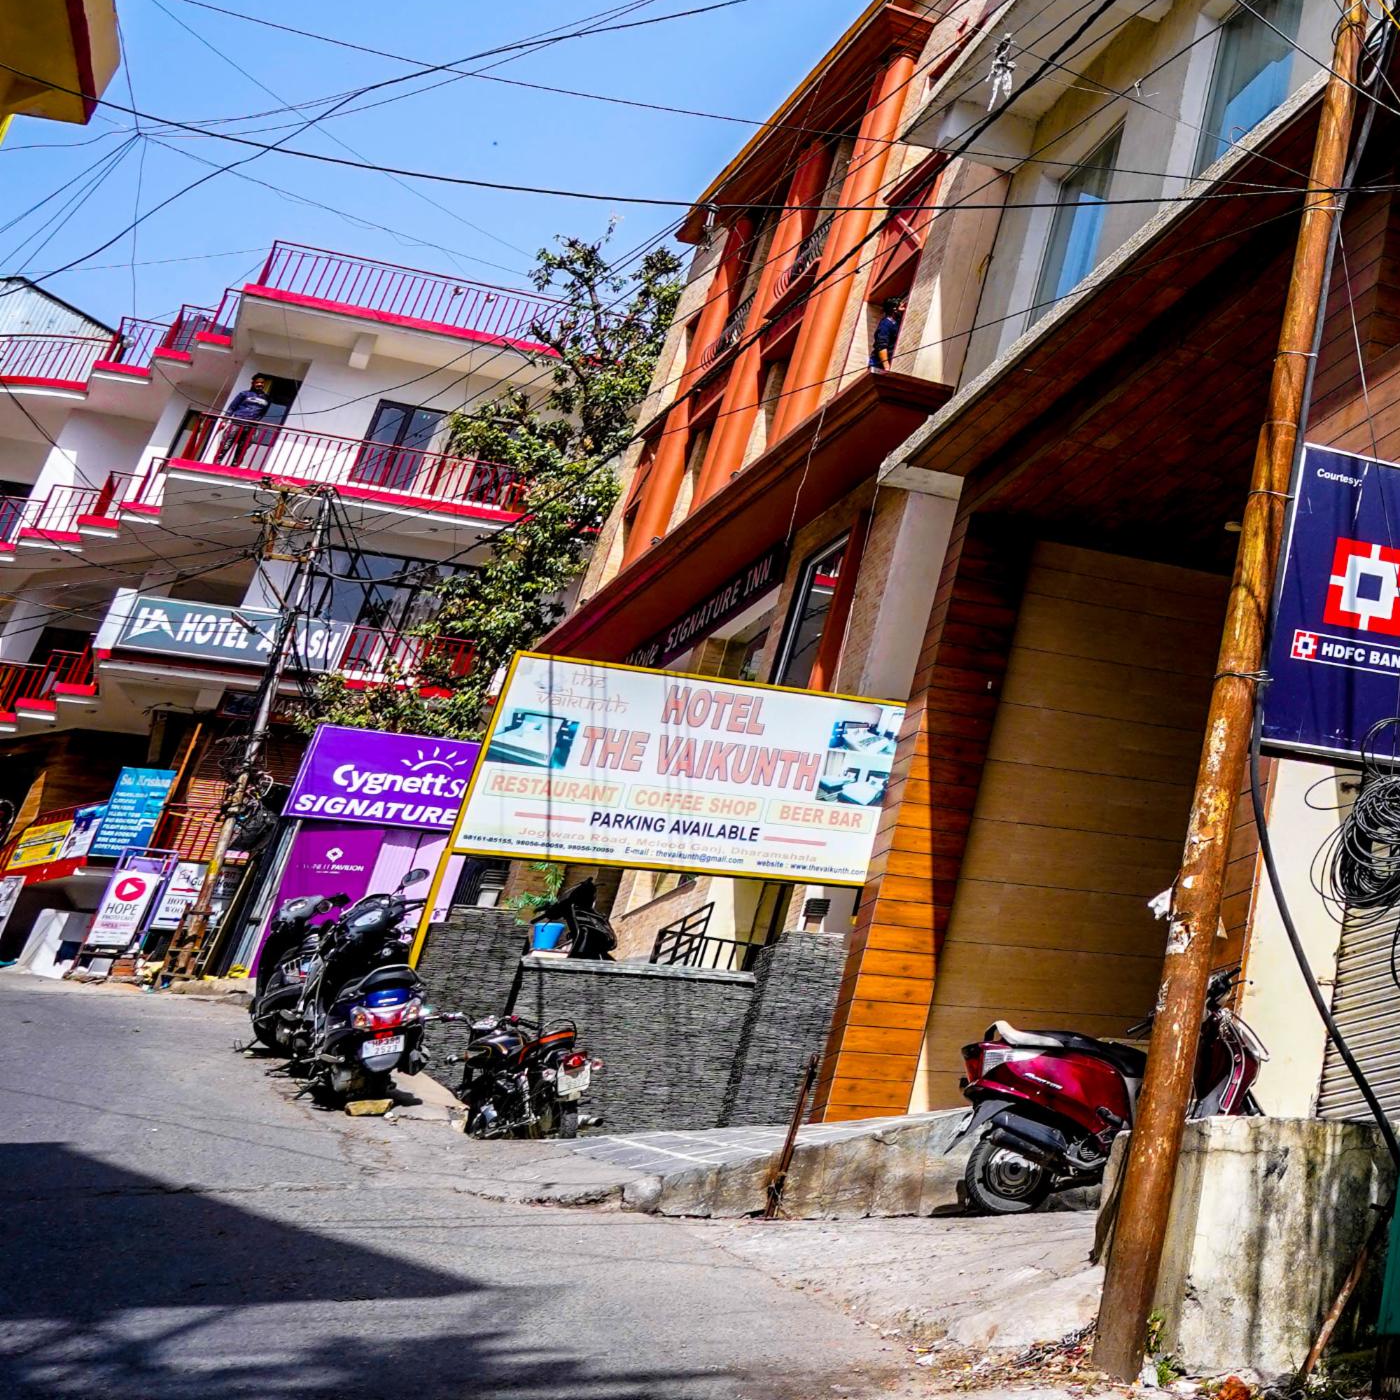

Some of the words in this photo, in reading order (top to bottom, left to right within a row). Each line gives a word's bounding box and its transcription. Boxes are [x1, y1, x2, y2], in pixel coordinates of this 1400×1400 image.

[1316, 468, 1362, 487] Courtesy:
[664, 579, 742, 653] SIGNATURE
[743, 554, 773, 596] INN
[175, 612, 250, 650] HOTEL
[256, 623, 342, 660] AASH
[1321, 643, 1366, 662] HDFC
[660, 684, 766, 736] HOTEL
[579, 725, 651, 773] THE
[656, 735, 822, 792] VAIKUNTH
[332, 764, 447, 798] Cygnett
[294, 793, 459, 826] SIGNATURE
[490, 774, 619, 803] RESTAURANT
[635, 789, 707, 812] COFFEE
[708, 797, 758, 817] SHOP
[779, 805, 825, 826] BEER
[828, 809, 863, 829] BAR
[589, 811, 666, 832] PARKING
[669, 818, 760, 842] AVAILABLE
[624, 847, 649, 856] E-mail
[656, 848, 744, 865] thevaikunth@gmail.com
[756, 859, 784, 869] website
[790, 863, 866, 876] www.thevaikunth.com
[731, 846, 817, 863] Dharamshala
[105, 902, 139, 915] HOPE
